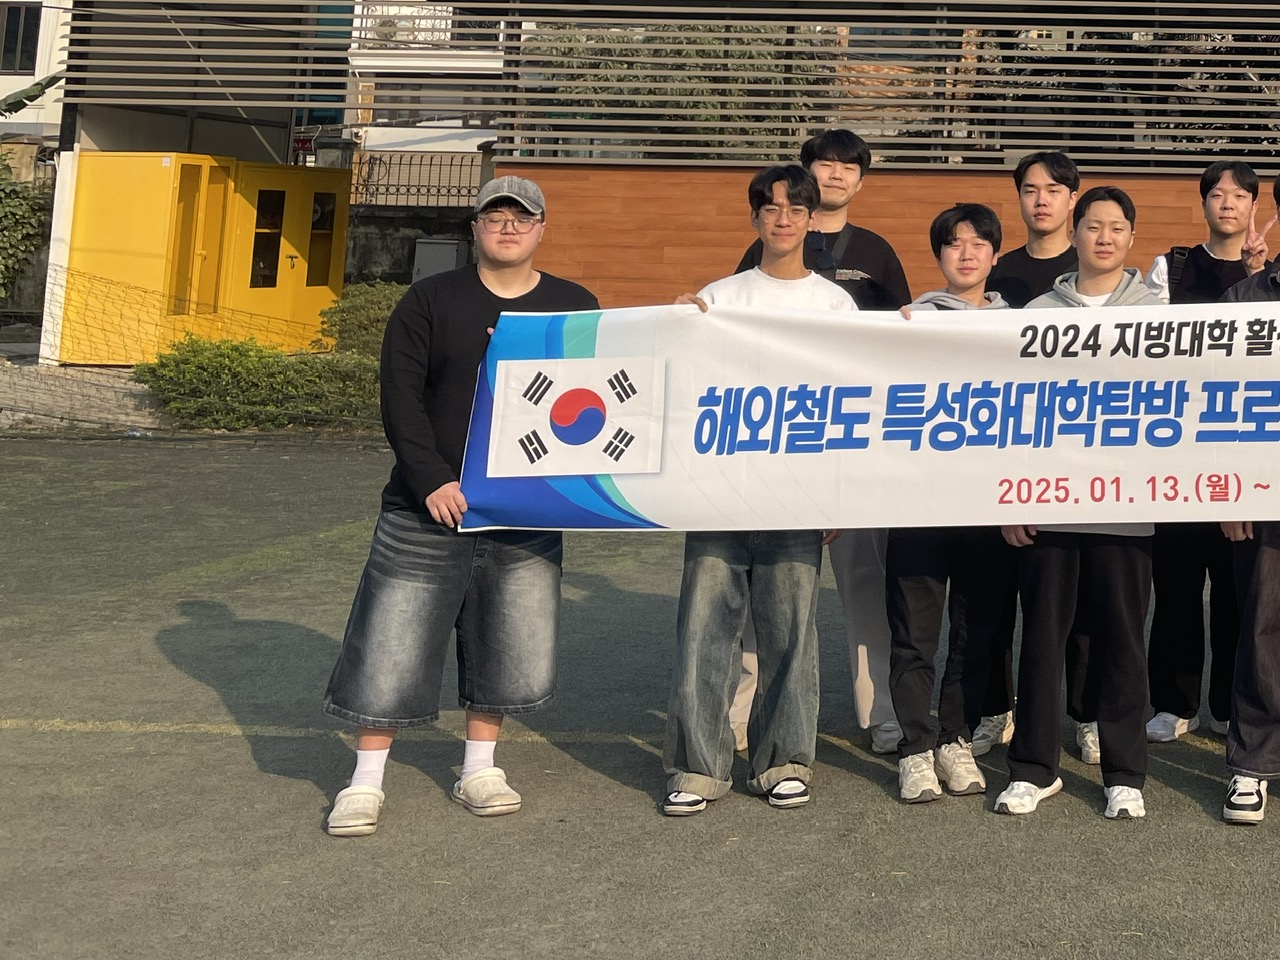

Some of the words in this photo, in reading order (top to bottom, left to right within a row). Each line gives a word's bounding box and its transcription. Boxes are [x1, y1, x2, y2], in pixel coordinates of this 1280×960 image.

[1019, 323, 1102, 359] 2024
[1110, 319, 1238, 359] 지방대학
[693, 384, 873, 456] 해외철도
[881, 379, 1190, 451] 특성화대학탐방
